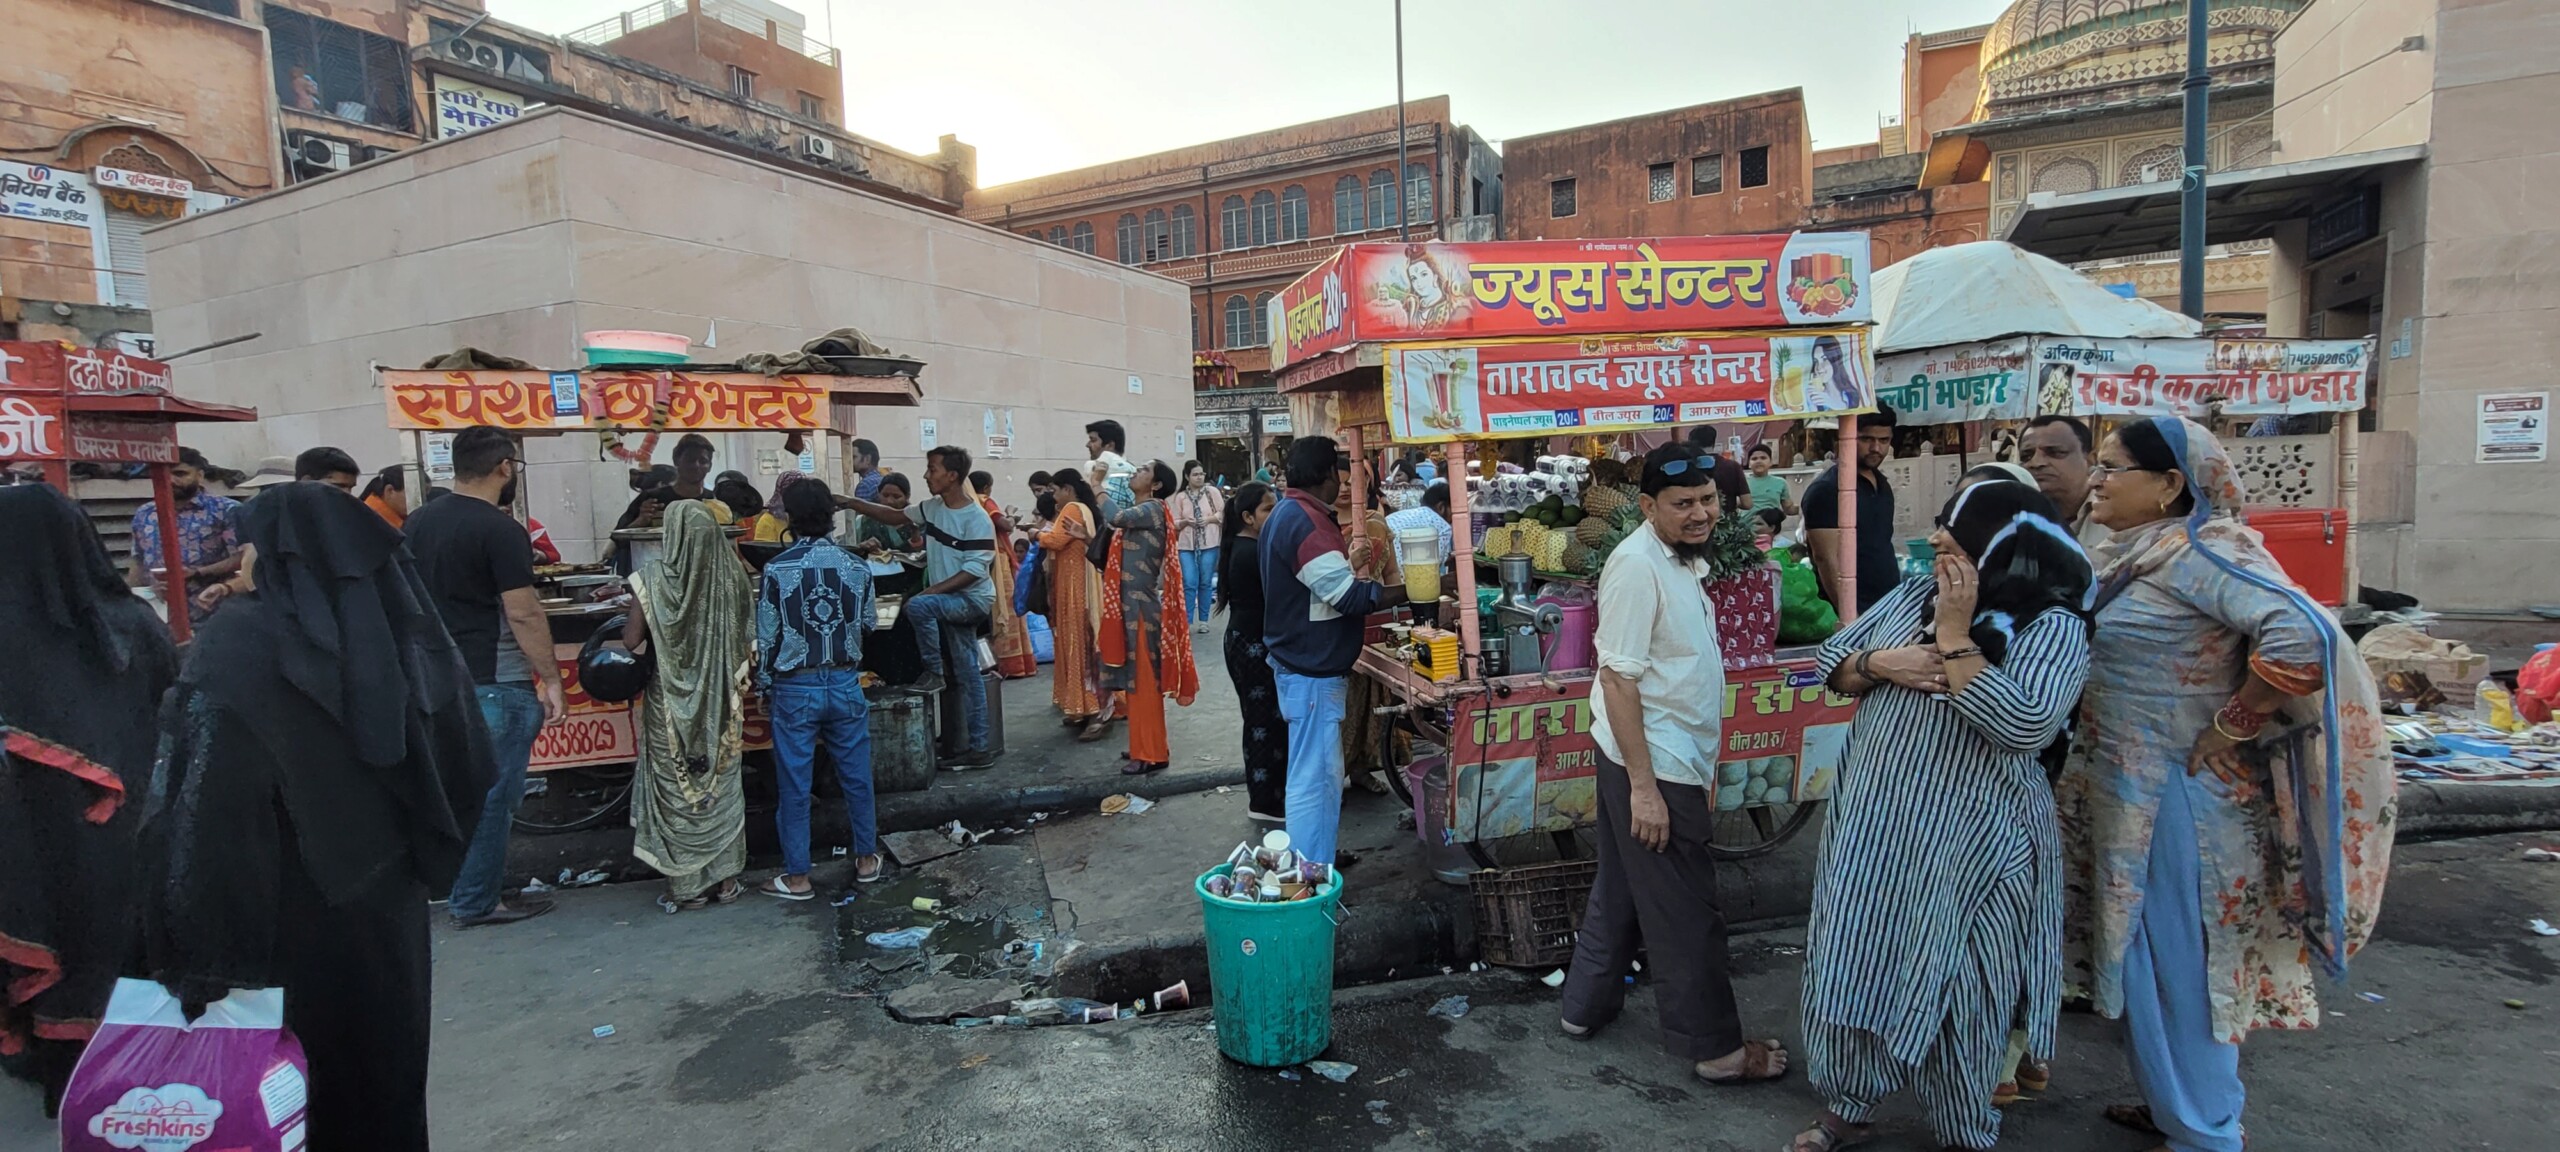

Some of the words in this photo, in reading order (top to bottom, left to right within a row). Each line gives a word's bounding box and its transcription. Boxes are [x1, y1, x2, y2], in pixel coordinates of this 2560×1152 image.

[438, 88, 478, 109] राधे
[482, 99, 520, 118] राधे
[0, 173, 54, 200] नियन
[55, 180, 87, 204] बैंक
[126, 173, 165, 186] यूनियन
[1469, 262, 1611, 323] ज्यूस
[1616, 243, 1770, 308] सेन्टर
[2044, 344, 2081, 361] अनिल
[107, 355, 136, 390] की
[1484, 357, 1609, 396] ताराचन्द
[1613, 355, 1686, 400] ज्यूस
[1689, 345, 1767, 386] सेन्टर
[1935, 373, 2013, 409] भण्डार
[2077, 364, 2160, 407] रबडी
[2267, 371, 2361, 403] भण्डार
[1557, 411, 1578, 426] 20/-
[1654, 406, 1674, 422] 20/-
[1689, 406, 1712, 417] आम
[1746, 402, 1766, 415] 20/-
[1469, 697, 1591, 745] तारा
[1753, 731, 1769, 749] 20
[1555, 751, 1582, 770] आम
[101, 1117, 207, 1137] Freshkins
